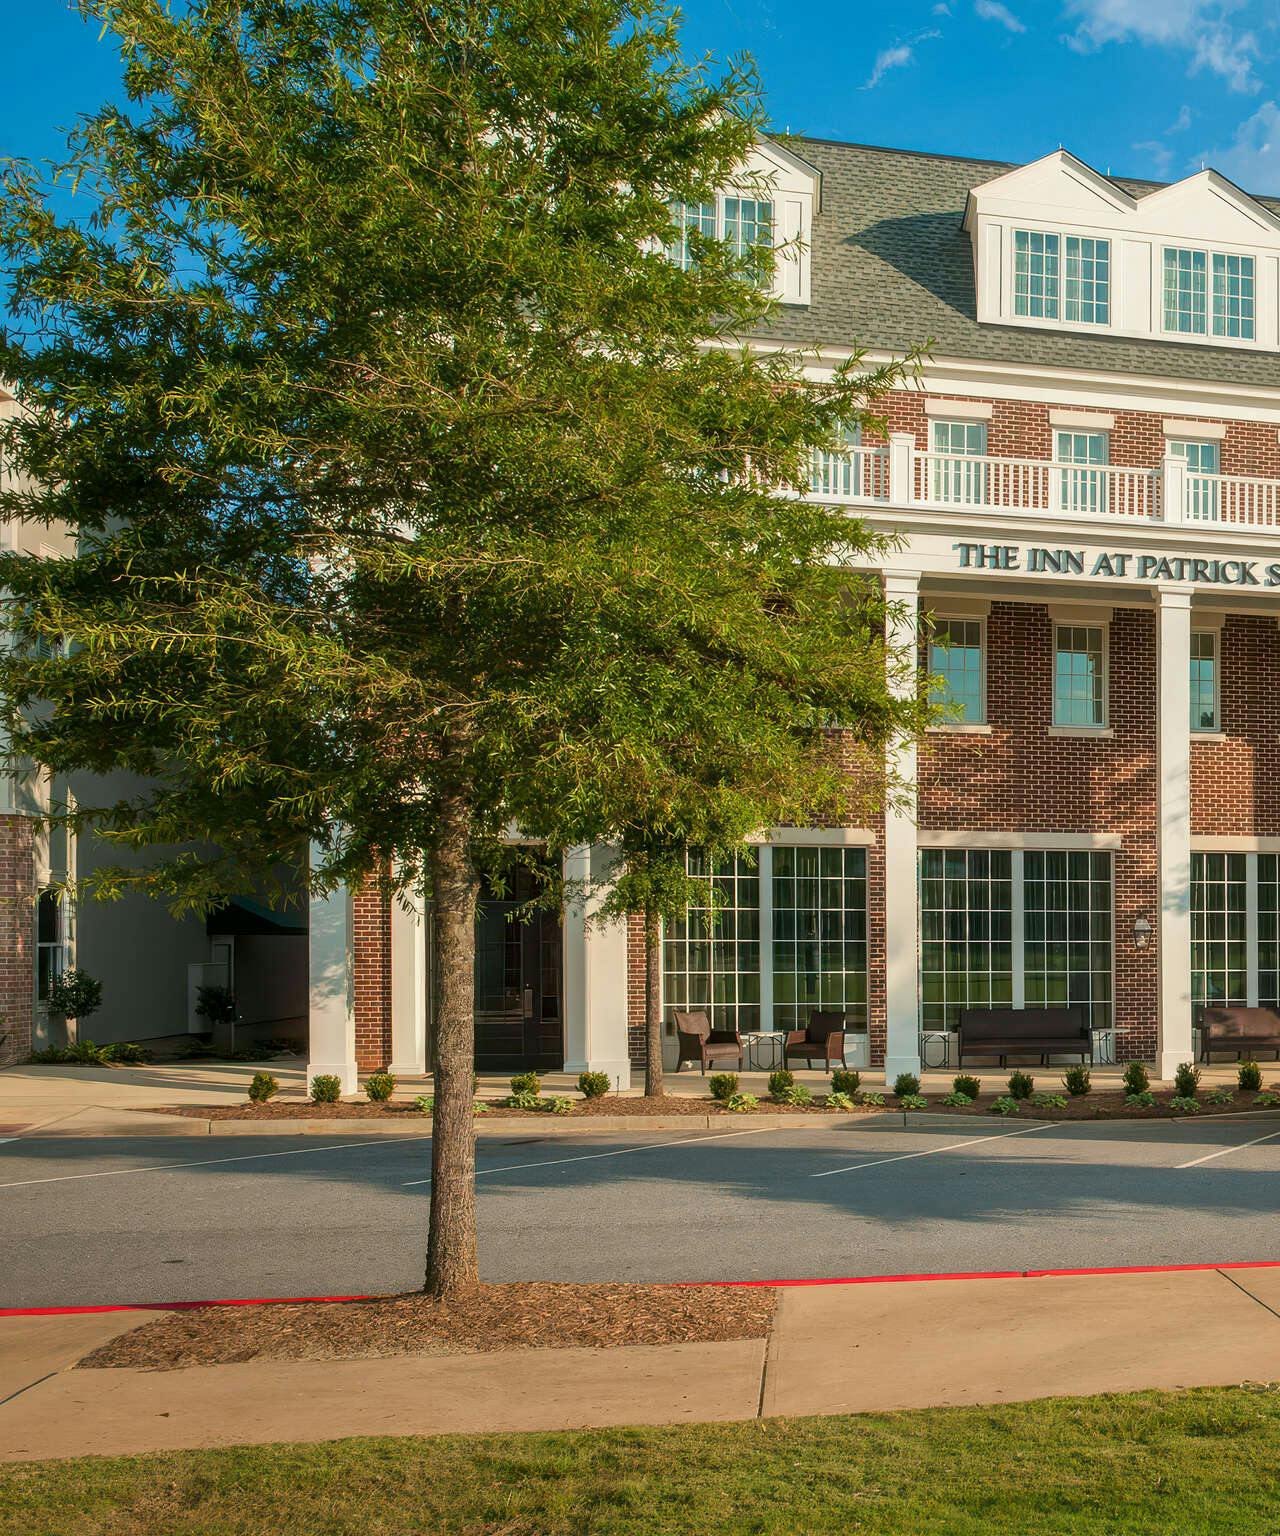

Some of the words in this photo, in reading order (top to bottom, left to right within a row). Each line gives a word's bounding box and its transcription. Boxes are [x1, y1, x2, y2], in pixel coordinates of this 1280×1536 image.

[952, 543, 1020, 570] THE
[1027, 548, 1085, 574] INN
[1091, 553, 1132, 577] AT
[1137, 555, 1260, 585] PATRICK
